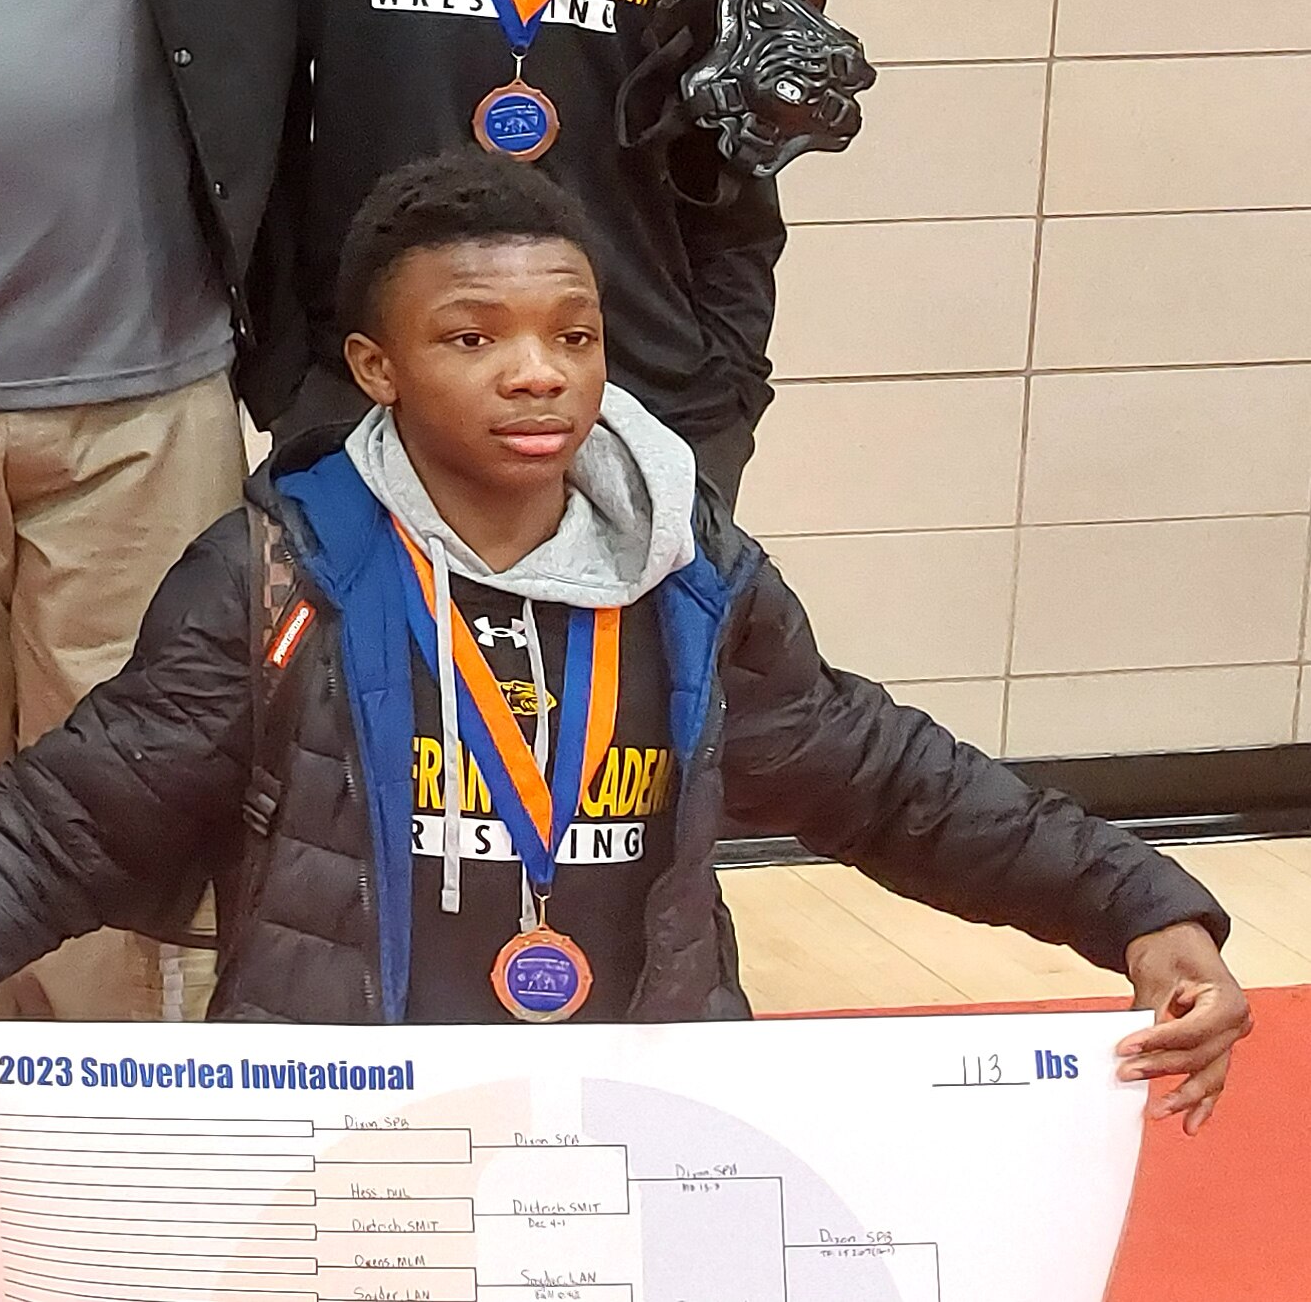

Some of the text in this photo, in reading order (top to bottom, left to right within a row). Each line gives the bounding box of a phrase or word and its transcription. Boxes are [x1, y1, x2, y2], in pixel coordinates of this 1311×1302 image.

[241, 1059, 415, 1091] Invitational
[962, 1049, 1079, 1085] 113 lbs
